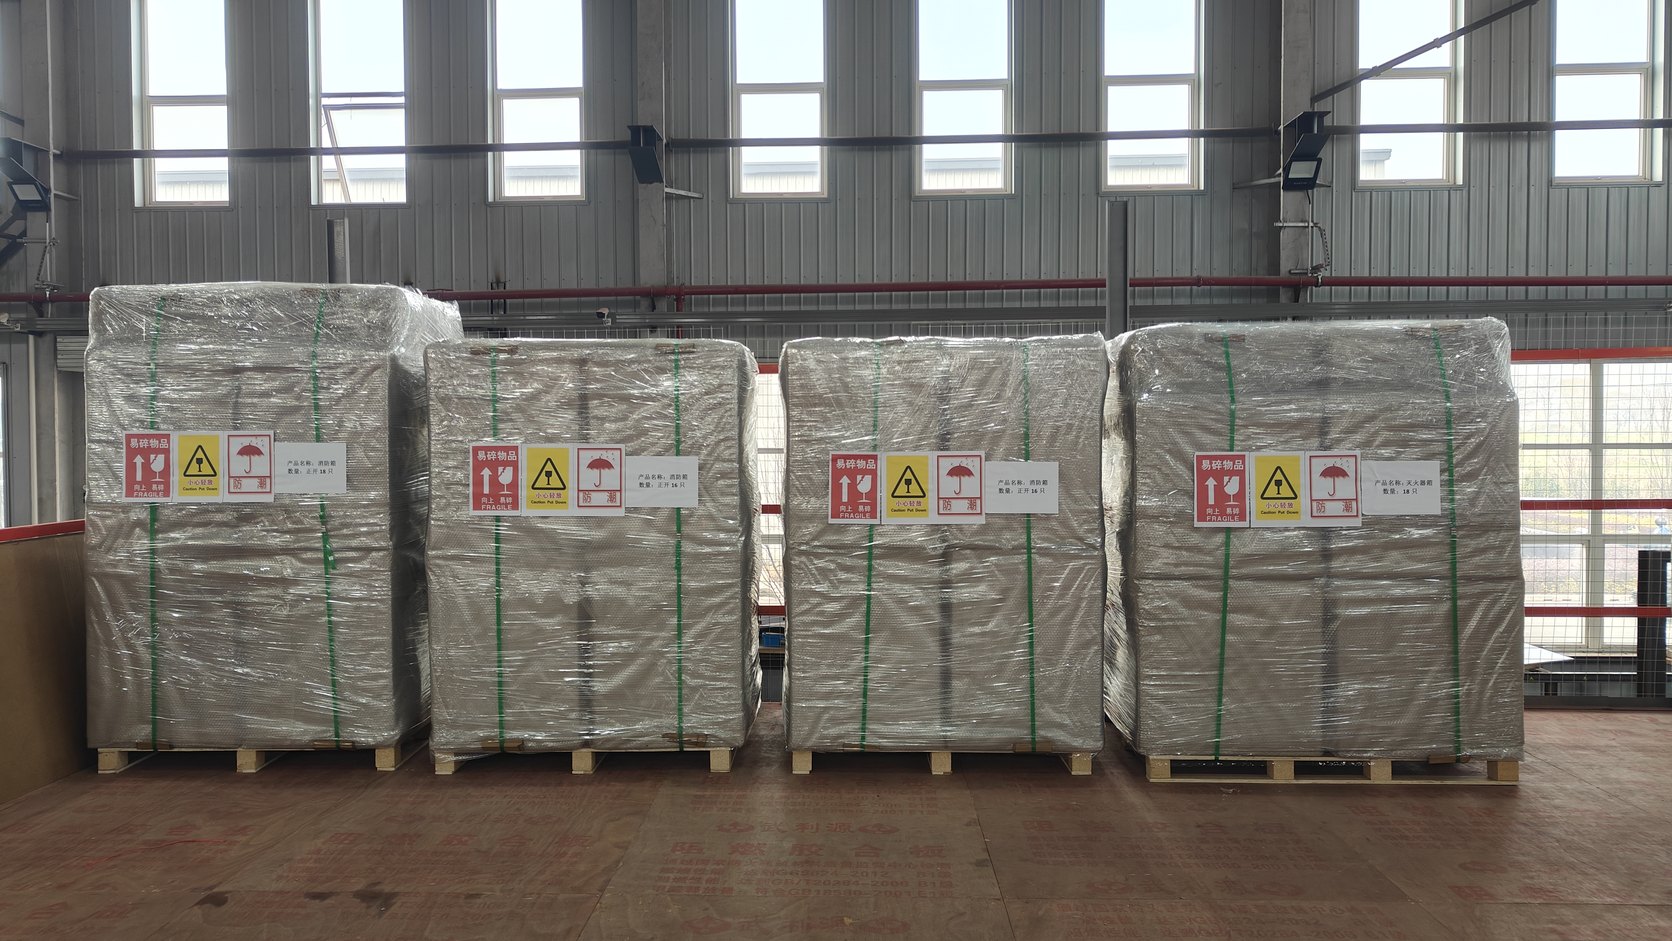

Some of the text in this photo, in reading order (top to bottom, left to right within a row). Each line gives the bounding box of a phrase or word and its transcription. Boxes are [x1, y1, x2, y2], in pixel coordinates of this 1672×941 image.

[130, 438, 169, 449] 易碎物品
[477, 451, 517, 461] 易碎物品
[836, 459, 876, 469] 易碎物品
[1202, 460, 1244, 470] 易碎物品
